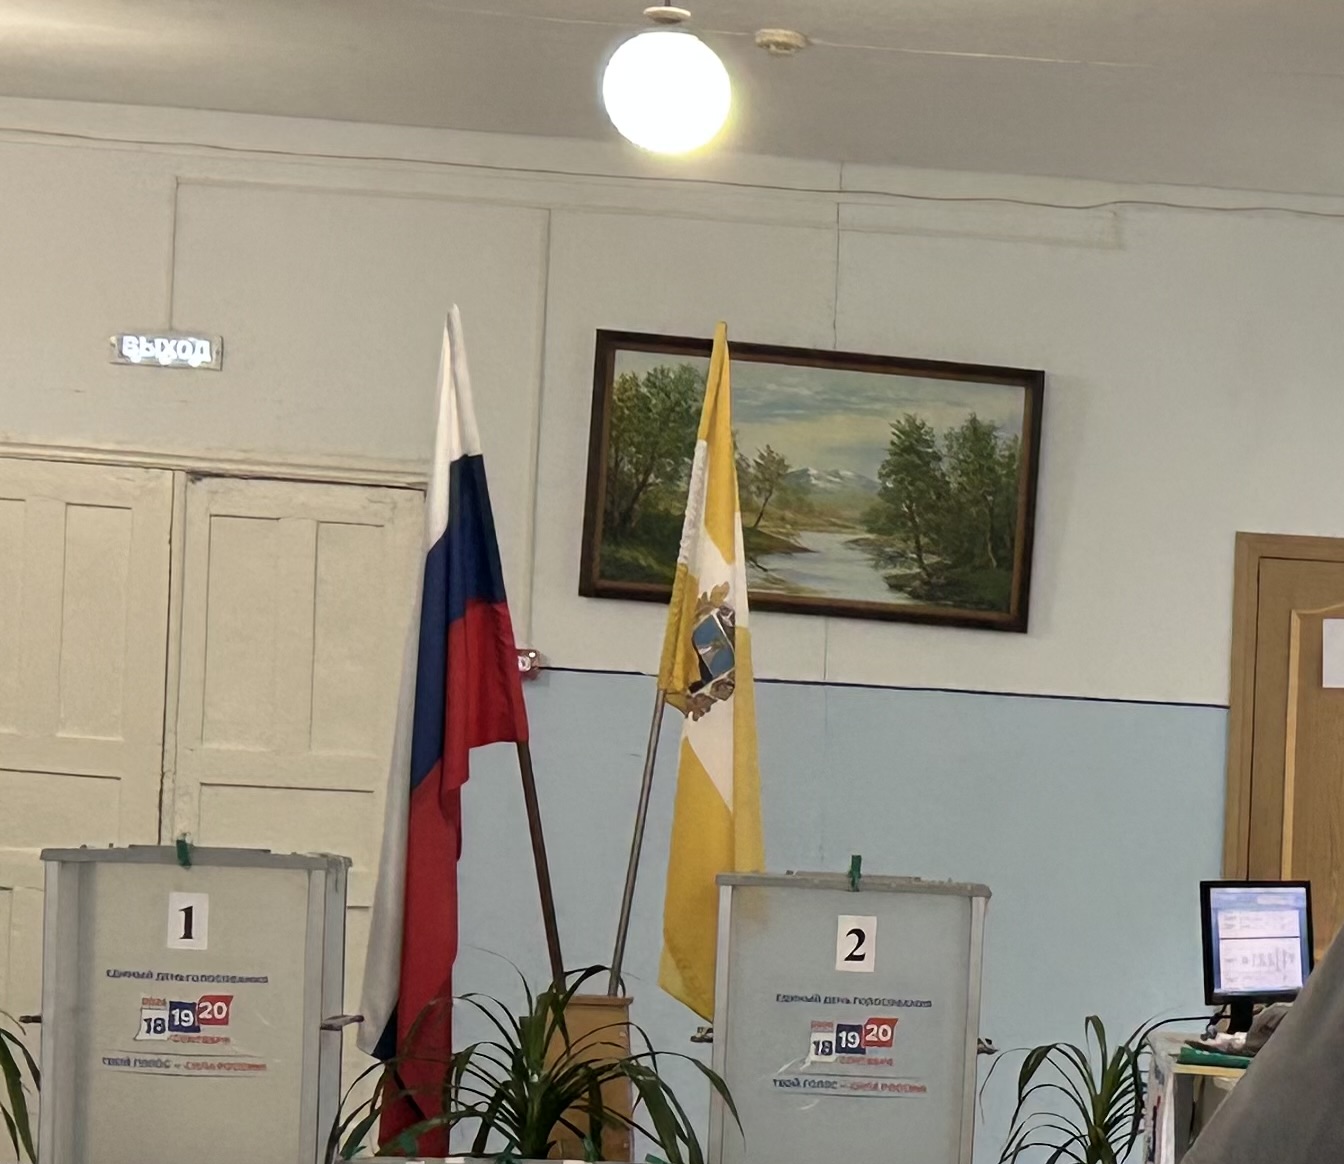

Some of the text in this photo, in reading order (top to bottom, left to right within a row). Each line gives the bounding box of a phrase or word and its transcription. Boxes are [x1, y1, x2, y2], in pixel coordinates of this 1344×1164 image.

[122, 335, 212, 363] ВЫХОД
[178, 905, 194, 940] 1
[843, 928, 867, 962] 2
[143, 1002, 228, 1035] 18 19 20
[813, 1024, 892, 1056] 18 19 20
